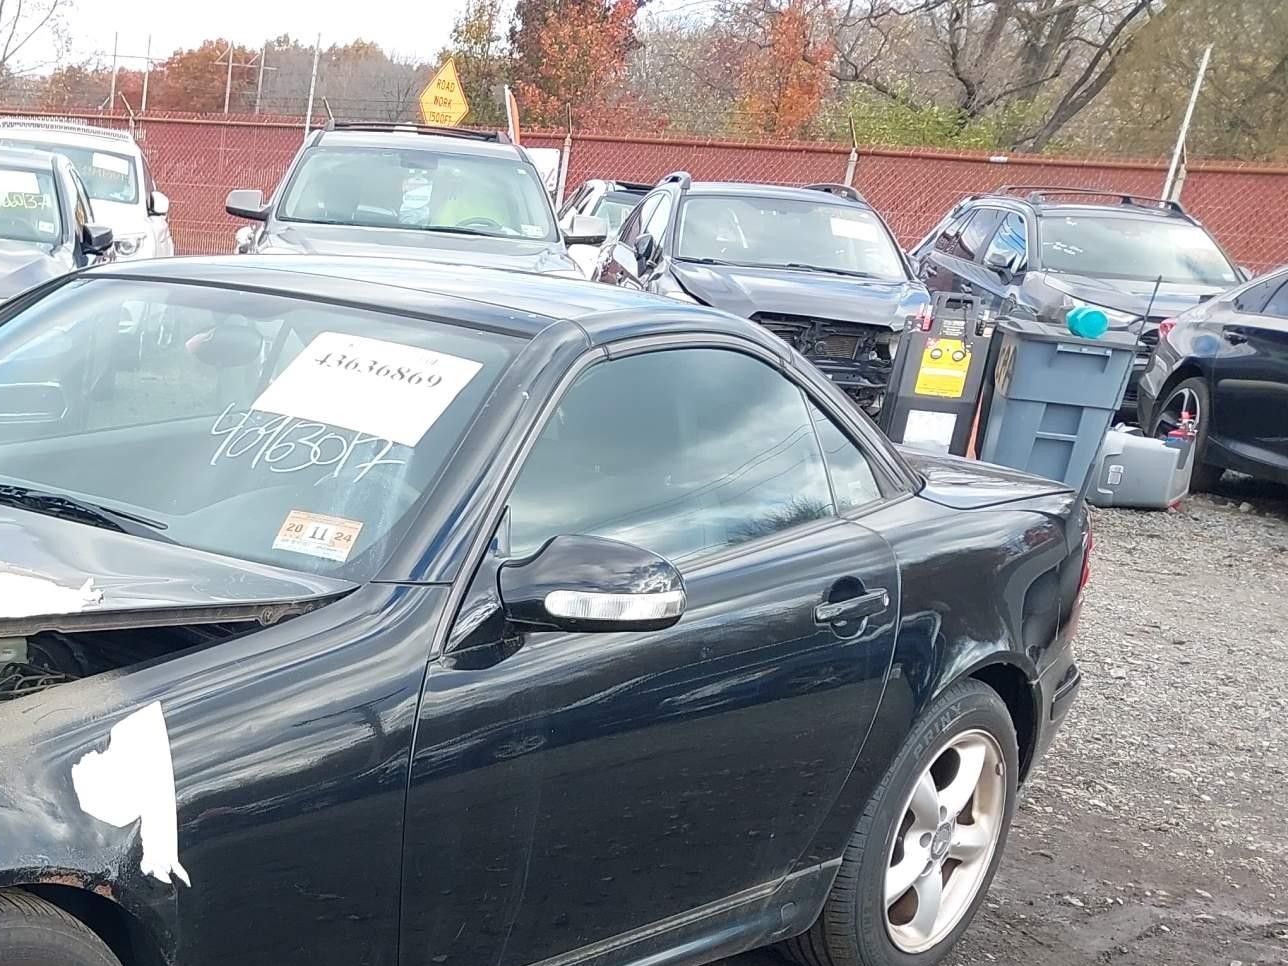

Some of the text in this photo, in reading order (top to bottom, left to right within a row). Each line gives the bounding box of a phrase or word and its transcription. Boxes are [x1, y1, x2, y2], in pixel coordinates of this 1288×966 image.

[436, 79, 455, 93] ROAD
[433, 95, 453, 109] WORK
[313, 353, 444, 389] 43636869
[286, 522, 353, 543] 20 11 24
